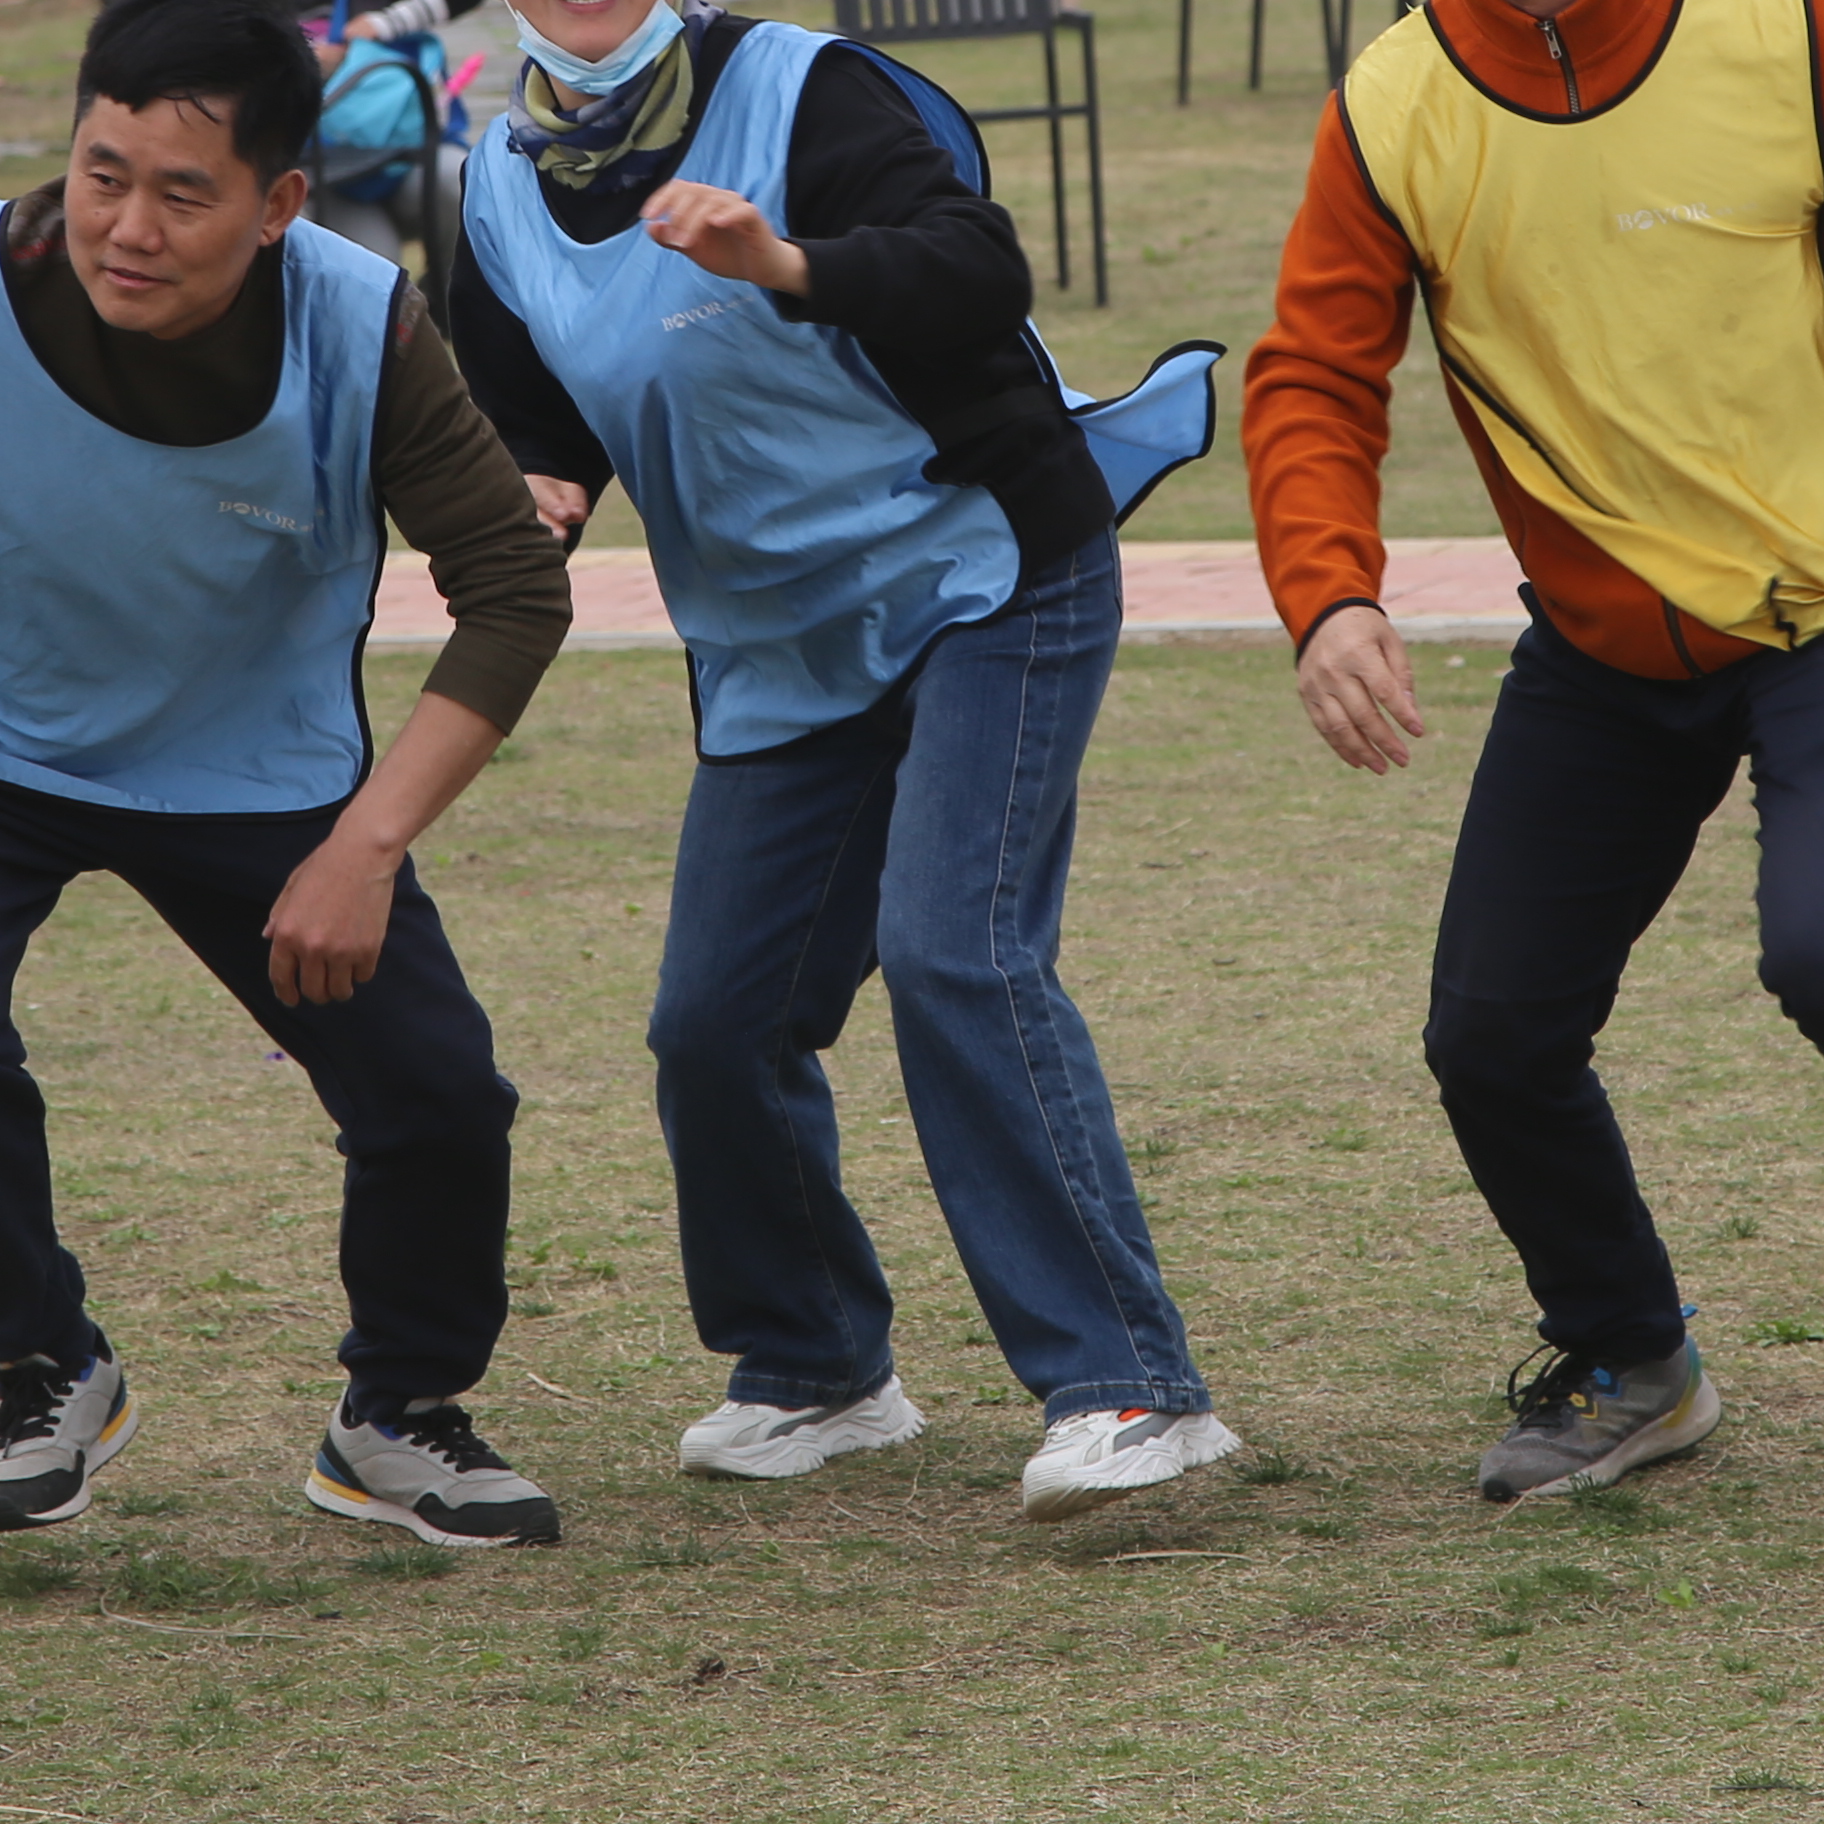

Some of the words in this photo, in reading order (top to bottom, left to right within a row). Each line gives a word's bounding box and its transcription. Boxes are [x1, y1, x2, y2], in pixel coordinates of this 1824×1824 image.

[1616, 201, 1712, 232] BOVOR
[660, 300, 726, 332] BOVOR
[218, 501, 297, 531] BOVOR
